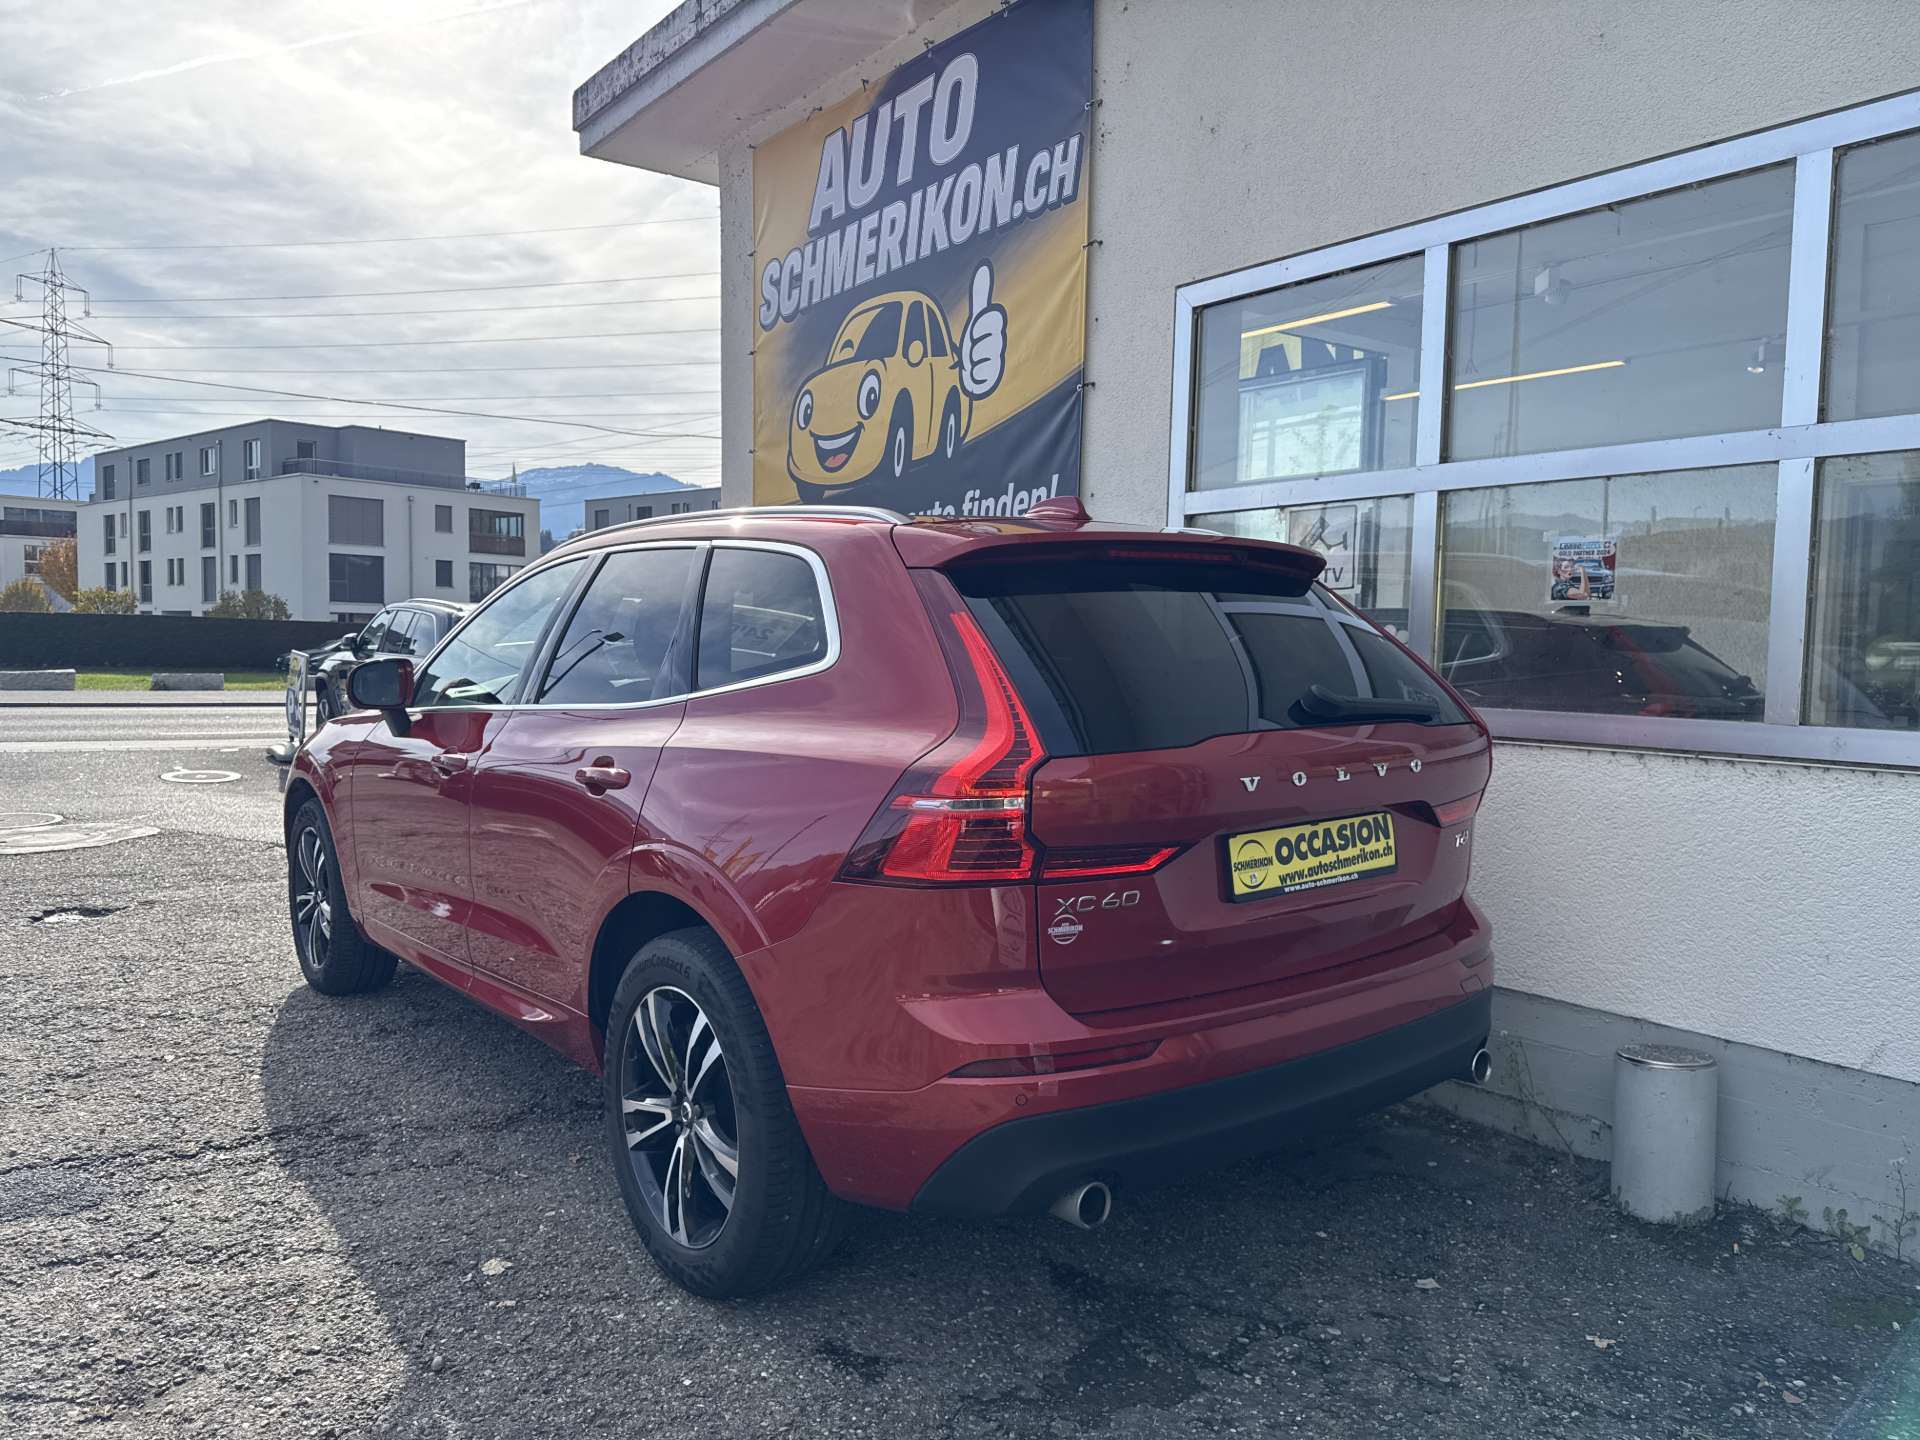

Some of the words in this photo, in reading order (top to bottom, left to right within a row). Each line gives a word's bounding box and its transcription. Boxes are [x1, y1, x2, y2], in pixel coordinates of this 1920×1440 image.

[808, 53, 979, 232] AUTO
[760, 133, 1082, 330] SCHMERIKON.CH
[1240, 758, 1422, 792] VOLVO
[1274, 817, 1391, 865] OCCASION
[1233, 856, 1273, 872] SCHMERIKON
[1278, 845, 1393, 885] www.autoschmerikon.ch
[1284, 873, 1359, 893] www.auto-schmerikon.ch
[1054, 890, 1140, 915] XC60
